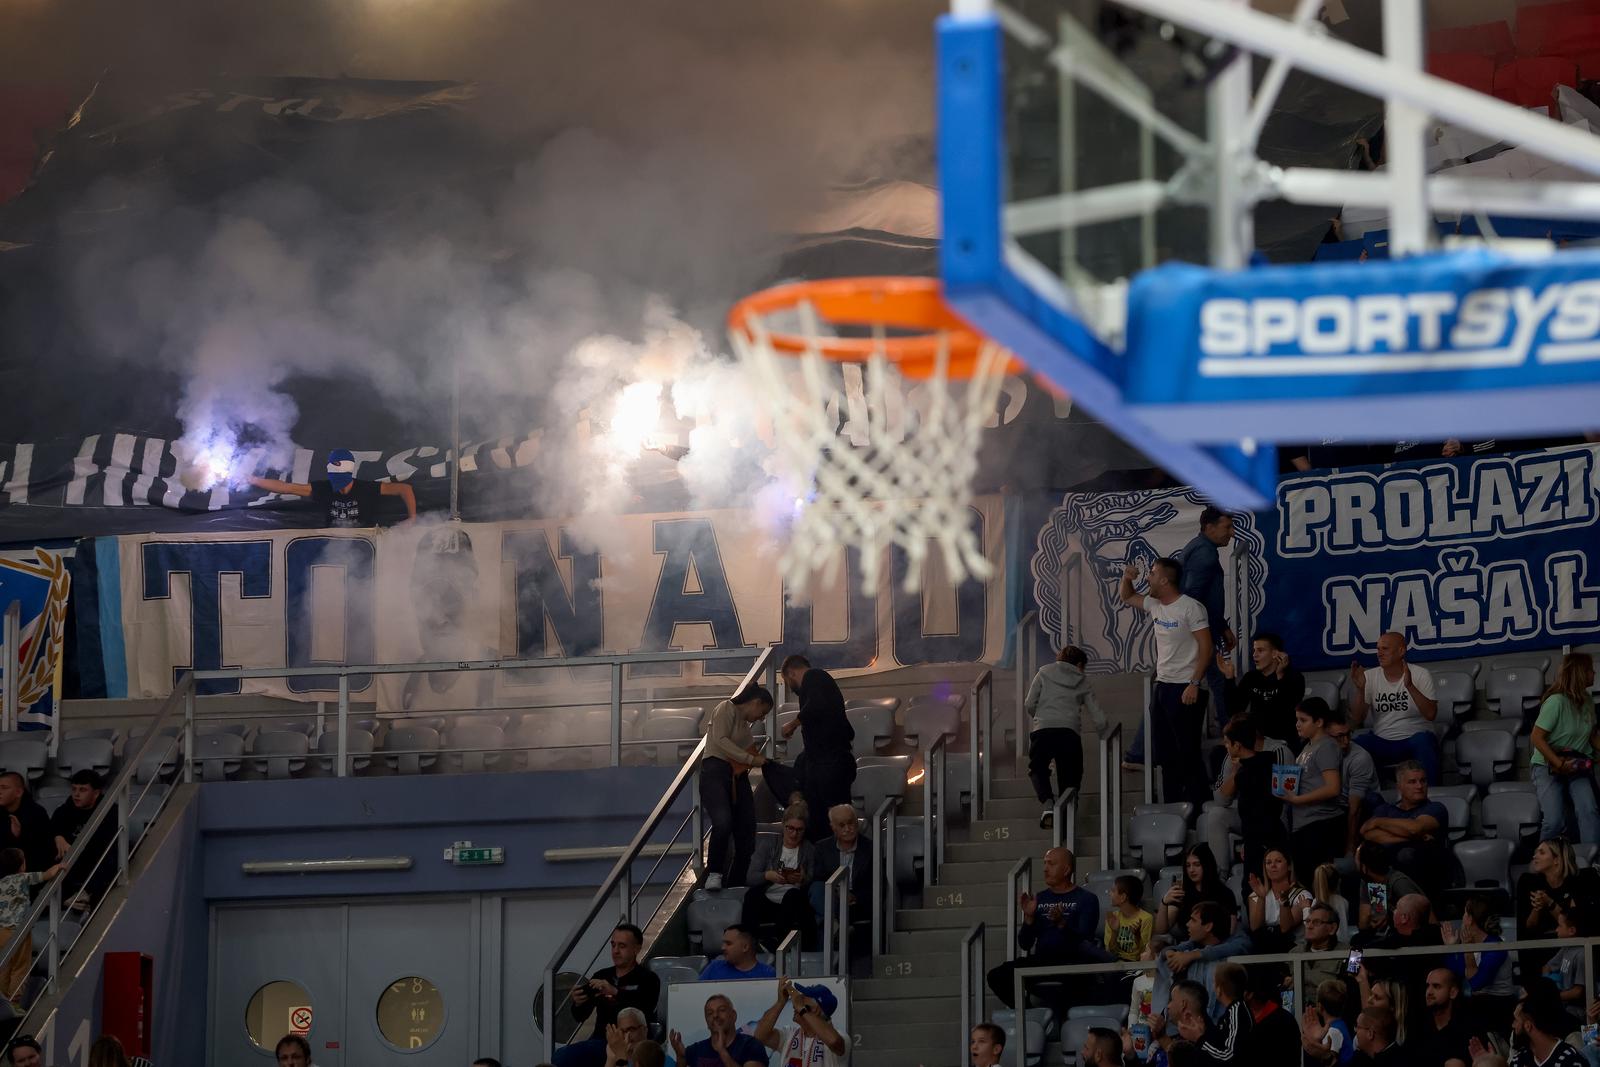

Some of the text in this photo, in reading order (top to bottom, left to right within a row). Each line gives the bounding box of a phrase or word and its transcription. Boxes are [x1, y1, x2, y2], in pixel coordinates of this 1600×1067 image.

[1282, 455, 1590, 549] PROLAZI
[1330, 556, 1534, 648] NAŠA
[1375, 702, 1408, 712] JONES
